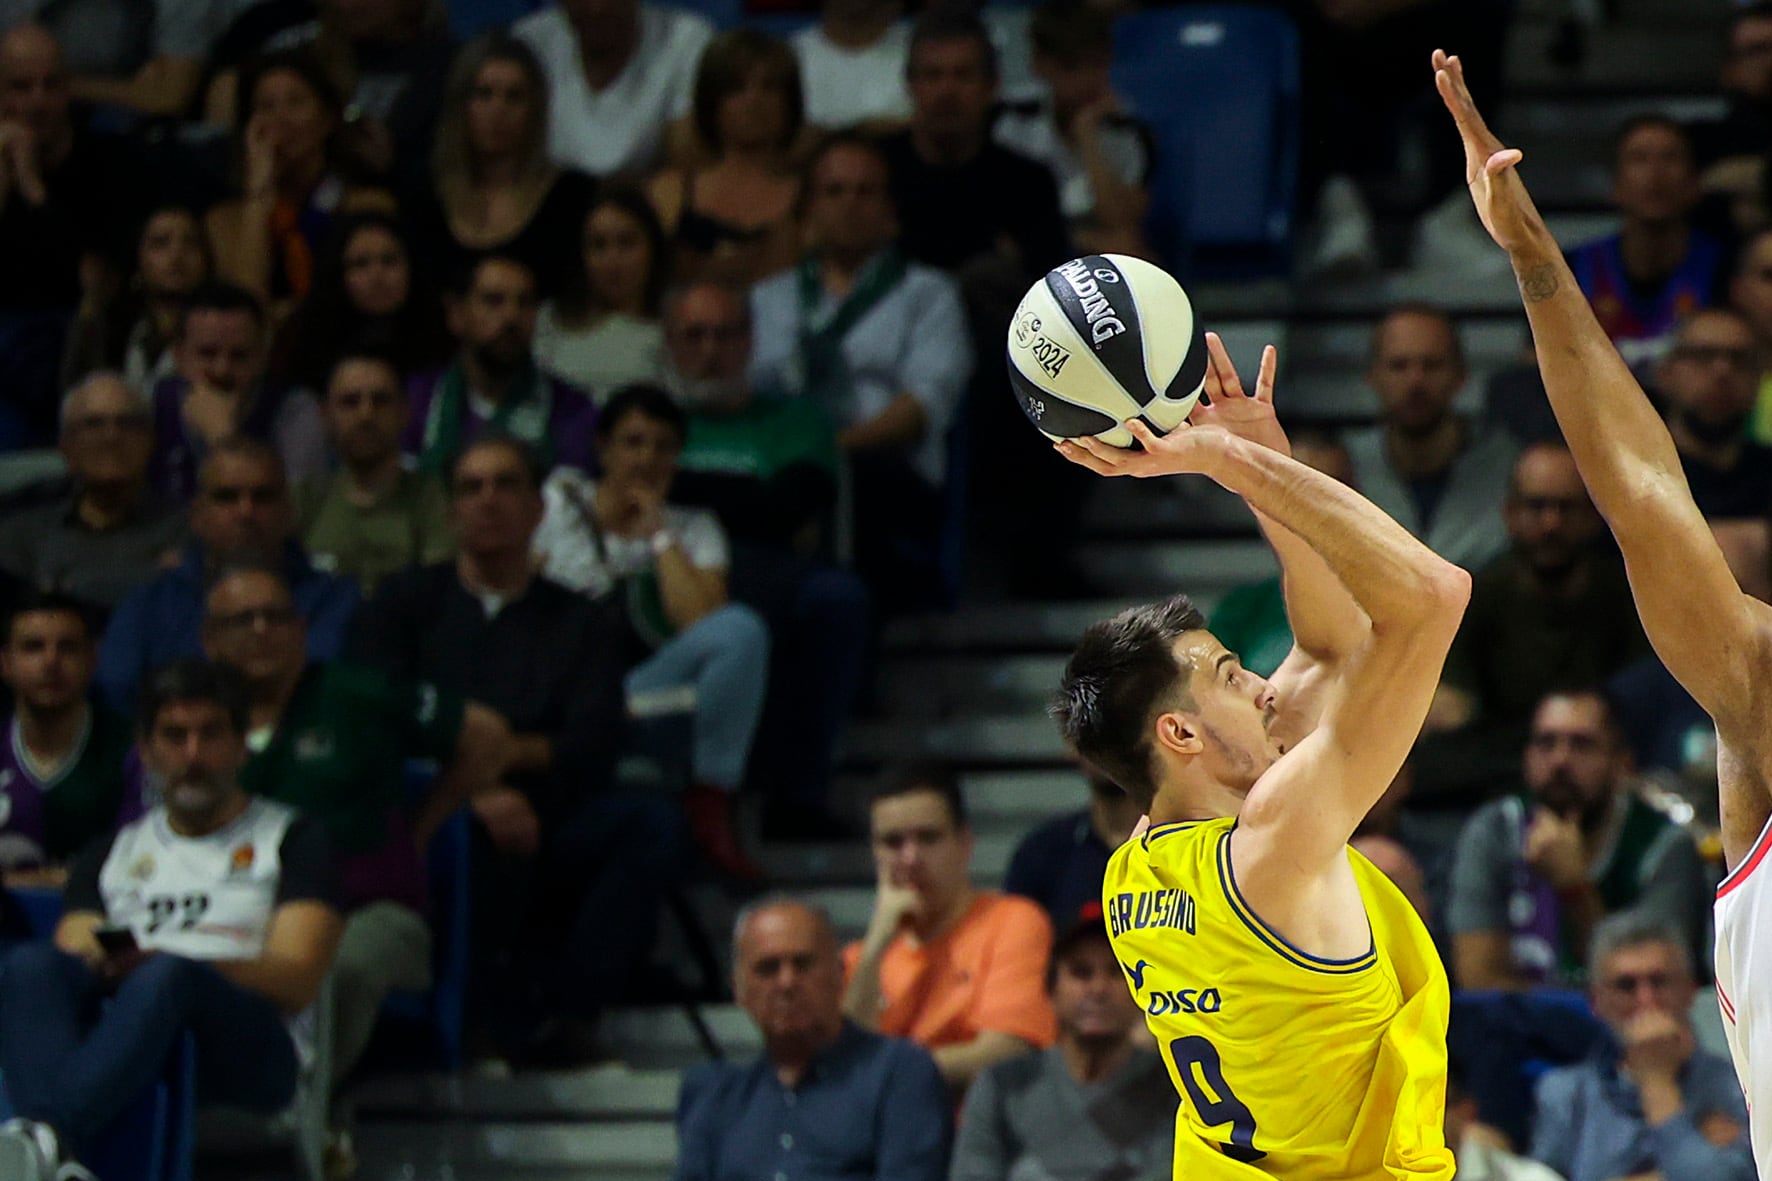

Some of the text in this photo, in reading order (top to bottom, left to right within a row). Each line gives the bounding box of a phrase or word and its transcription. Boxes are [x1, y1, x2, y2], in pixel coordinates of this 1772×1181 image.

[1056, 257, 1127, 345] PALDING
[1032, 337, 1071, 379] 2024
[1169, 1035, 1268, 1163] 9
